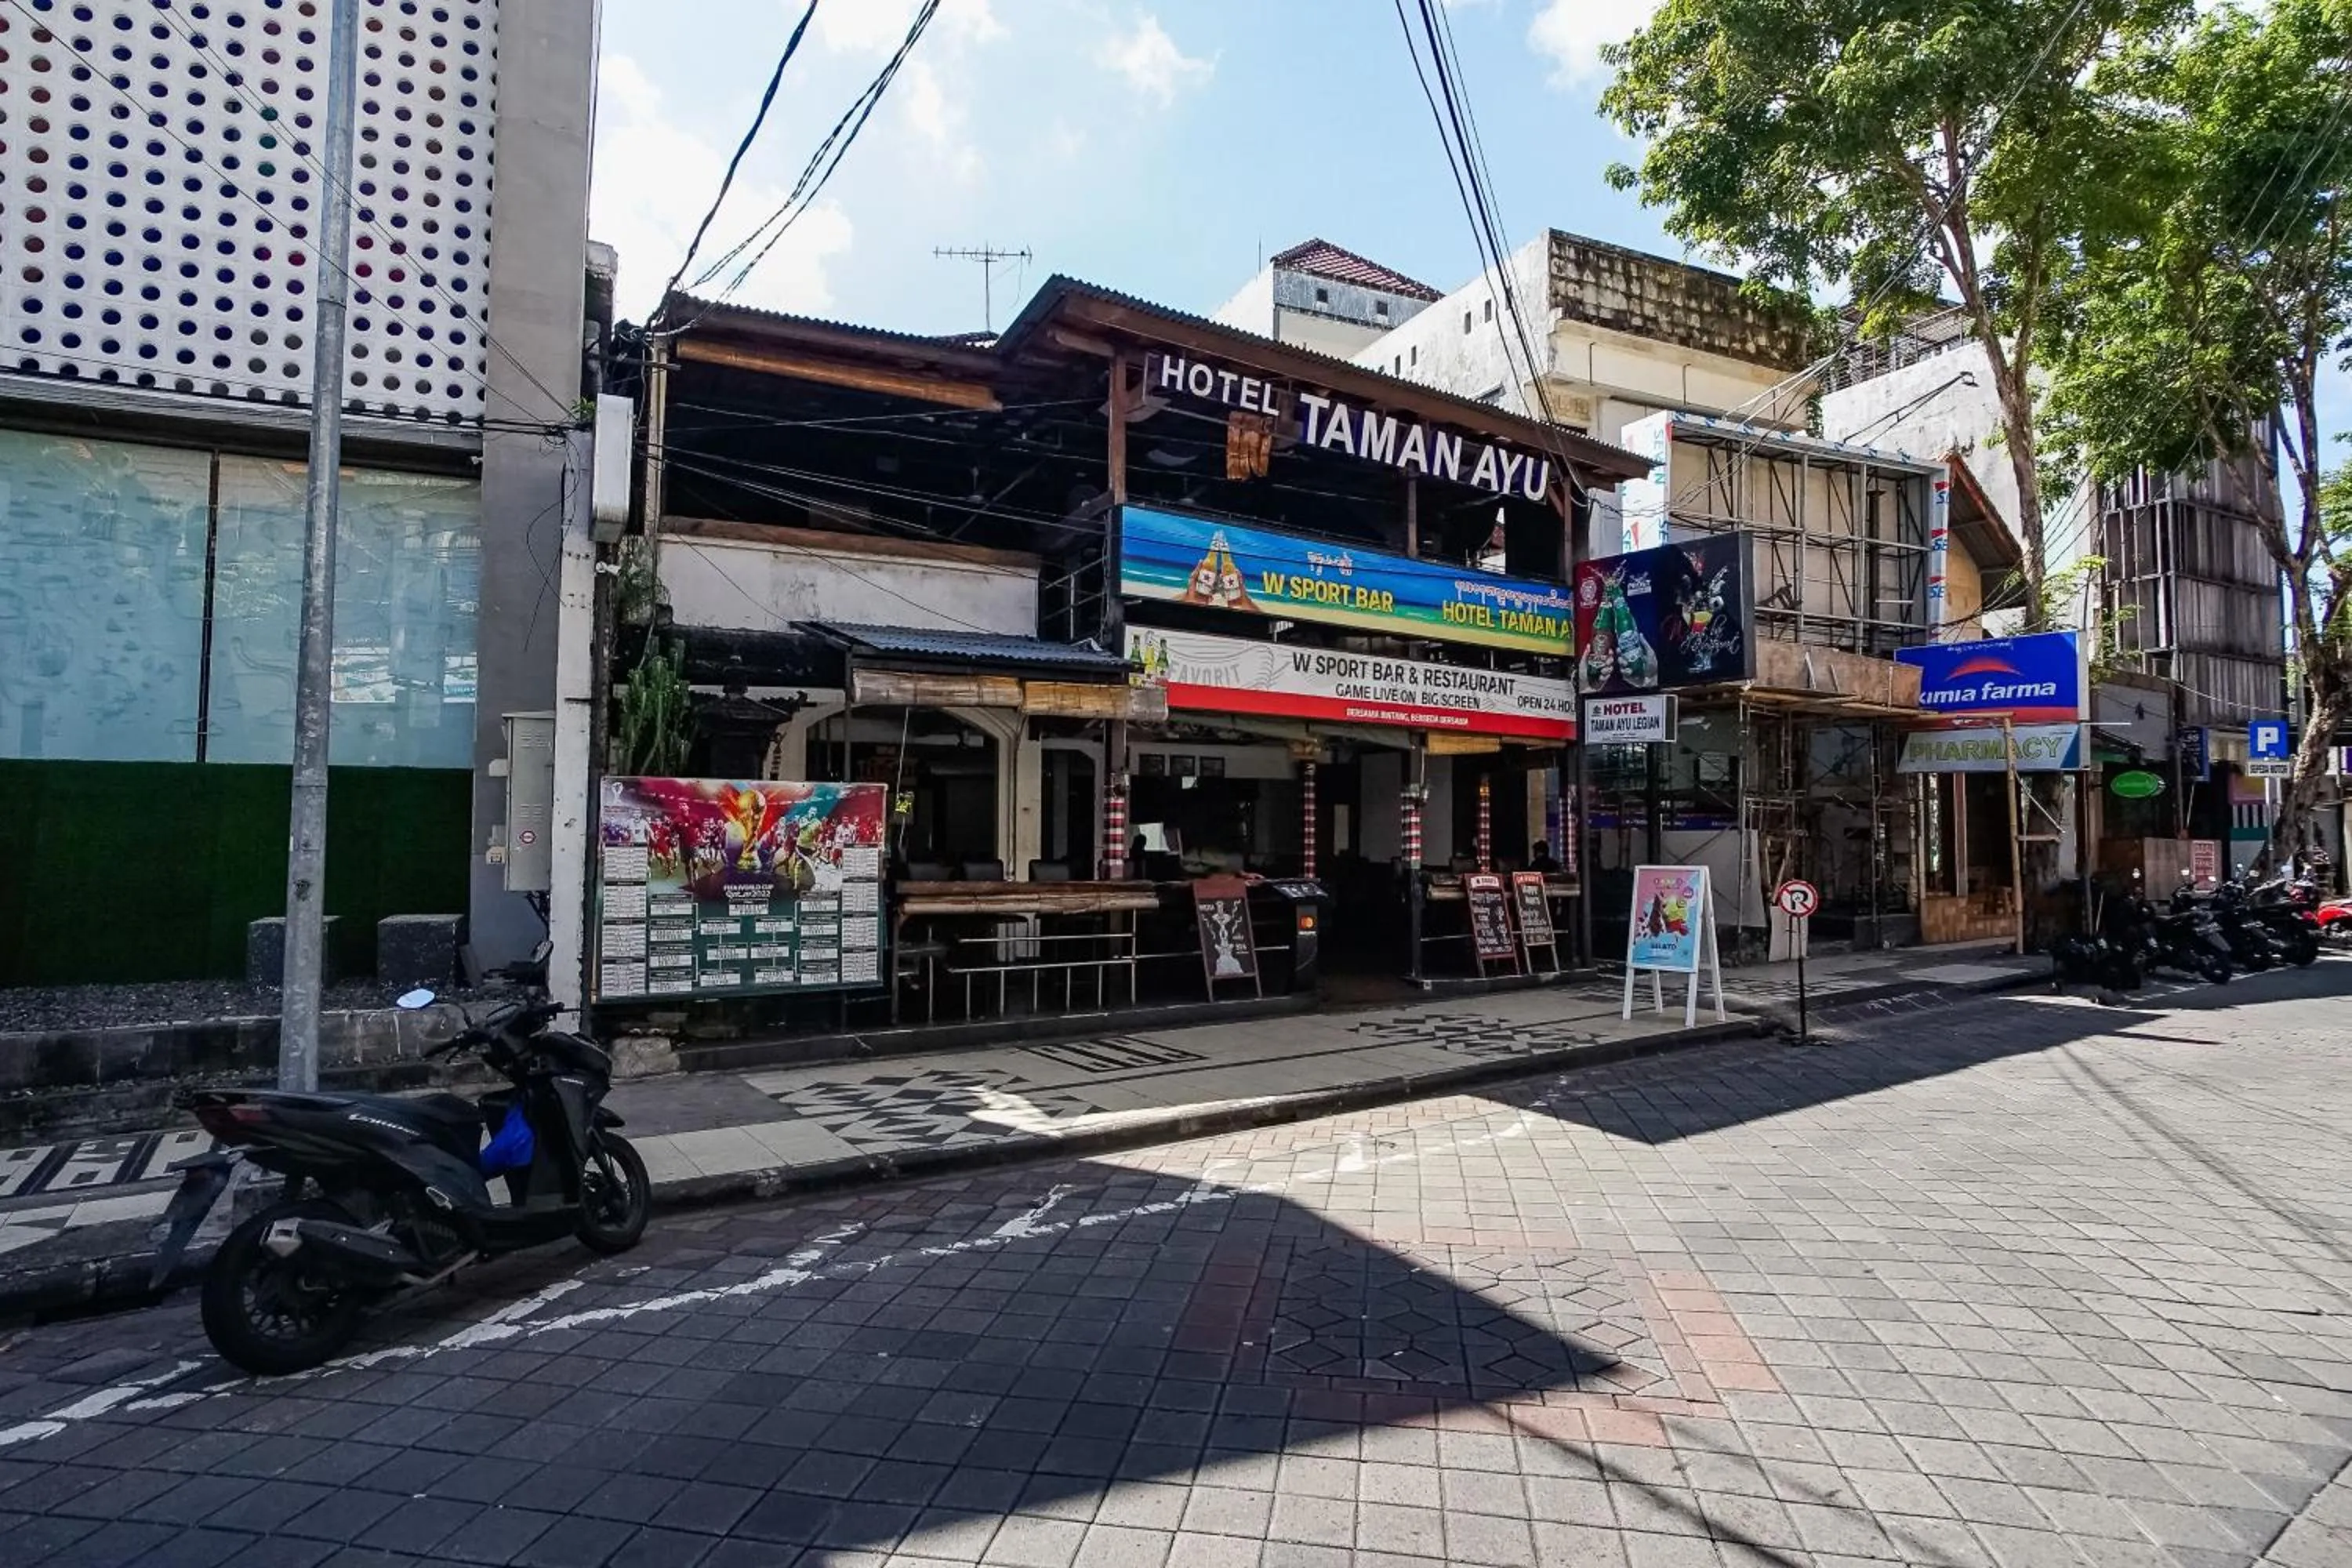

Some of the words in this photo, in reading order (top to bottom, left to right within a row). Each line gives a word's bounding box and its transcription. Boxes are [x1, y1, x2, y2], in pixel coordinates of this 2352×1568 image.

[1161, 354, 1279, 416] HOTEL
[1300, 394, 1463, 481] TAMAN
[1470, 445, 1549, 502] AYU
[1262, 571, 1285, 595] W
[1290, 576, 1352, 606] SPORT
[1356, 586, 1393, 612] BAR
[1442, 599, 1495, 627] HOTEL
[1499, 609, 1556, 637] TAMAN
[1294, 652, 1311, 673] W
[1316, 655, 1368, 679] SPORT
[1372, 662, 1404, 683] BAR
[1409, 666, 1418, 684] &
[1423, 669, 1516, 695] RESTAURANT
[1335, 683, 1371, 699] GAME
[1373, 688, 1398, 702] LIVE
[1400, 690, 1416, 704] ON
[1421, 691, 1439, 706] BIG
[1440, 694, 1481, 710] SCREEN
[1517, 695, 1541, 710] OPEN
[1544, 698, 1555, 711] 24
[1981, 681, 2056, 701] farma
[1603, 702, 1646, 715] HOTEL
[1591, 718, 1615, 732] TAMAN
[1617, 718, 1631, 731] AYU
[1633, 715, 1660, 730] LEGIAN
[1908, 736, 2062, 761] PHARMACY
[2257, 727, 2279, 751] P
